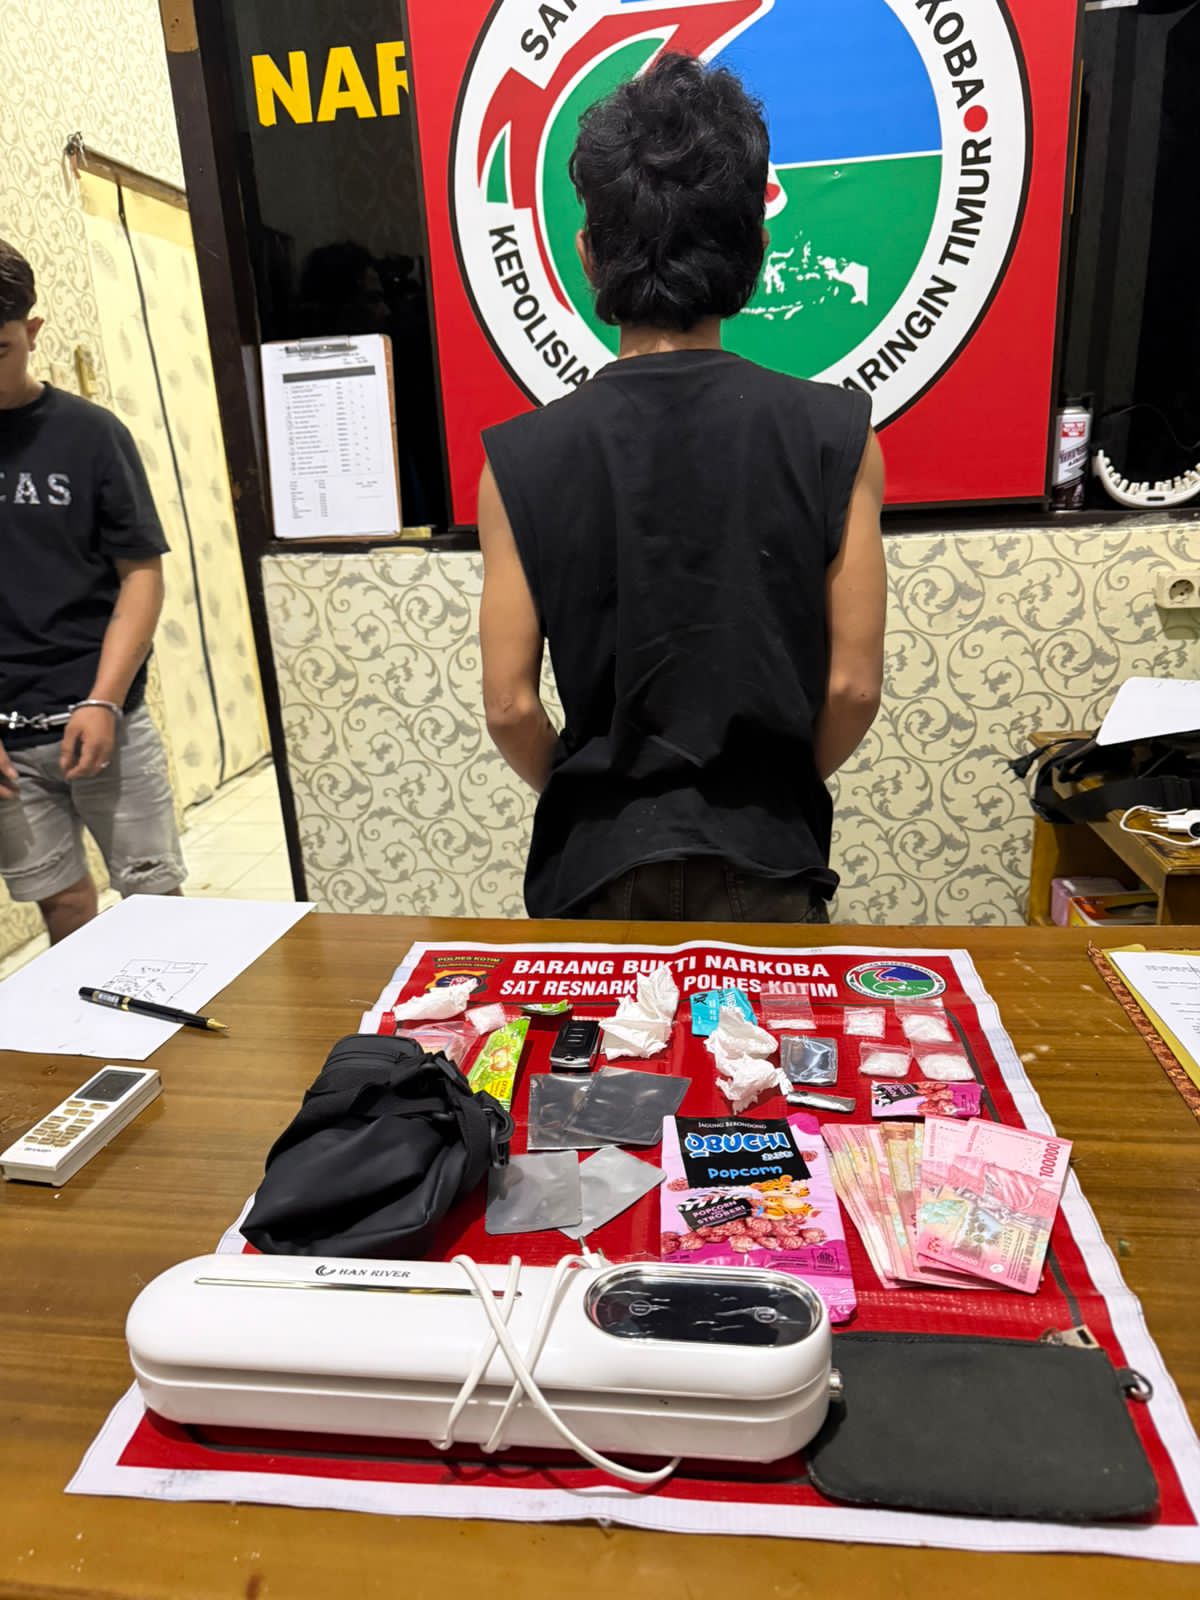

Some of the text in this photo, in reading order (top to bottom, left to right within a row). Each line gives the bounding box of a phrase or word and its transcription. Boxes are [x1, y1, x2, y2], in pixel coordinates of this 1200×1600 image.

[938, 136, 992, 266] TIMUR
[0, 472, 72, 506] AS
[512, 959, 615, 975] BARANG
[704, 955, 830, 977] NARKOBA
[499, 980, 540, 996] SAT
[683, 974, 763, 993] POLRES
[767, 981, 838, 998] KOTIM
[684, 1132, 792, 1159] QBUCHI
[1039, 1142, 1061, 1178] 100000
[708, 1165, 783, 1180] Popcorn
[691, 1201, 737, 1218] POPCORN
[697, 1205, 746, 1226] STROBERI
[338, 1268, 411, 1279] HAN RIVER
